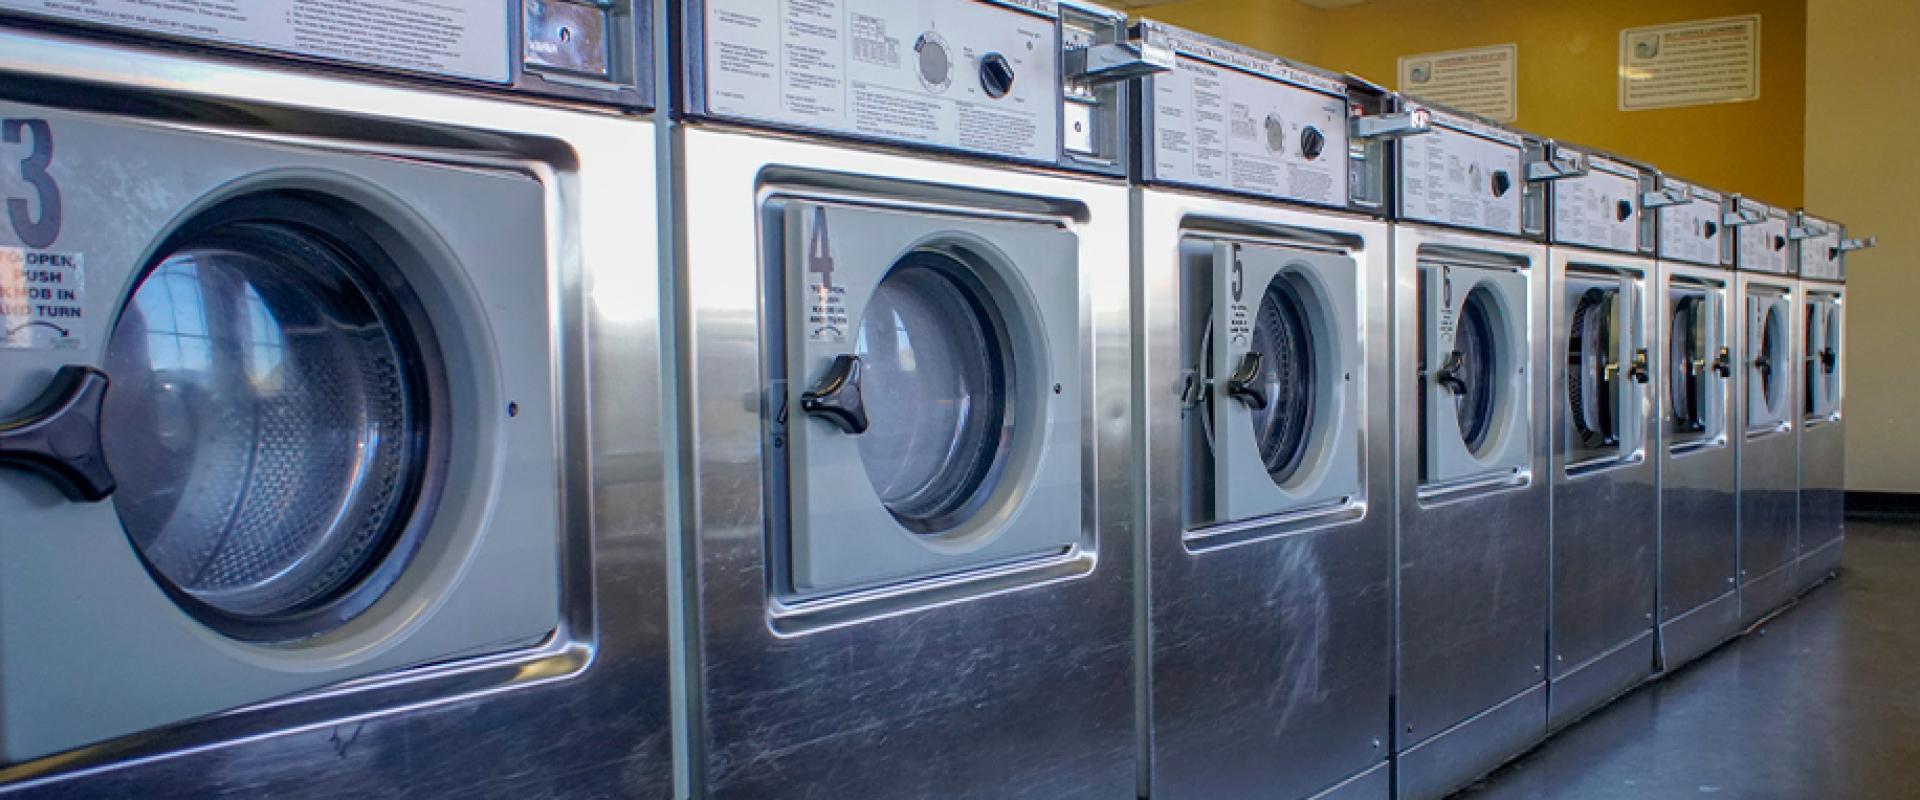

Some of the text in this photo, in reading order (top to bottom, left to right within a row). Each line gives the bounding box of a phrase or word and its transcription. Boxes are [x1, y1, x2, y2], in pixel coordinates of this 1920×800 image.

[2, 118, 62, 249] 3
[27, 253, 76, 270] OPEN,
[809, 206, 834, 290] 4
[15, 269, 62, 283] PUSH
[1231, 243, 1243, 302] 5
[1443, 266, 1452, 308] 6
[0, 286, 75, 300] KNOB IN
[36, 305, 81, 318] TURN
